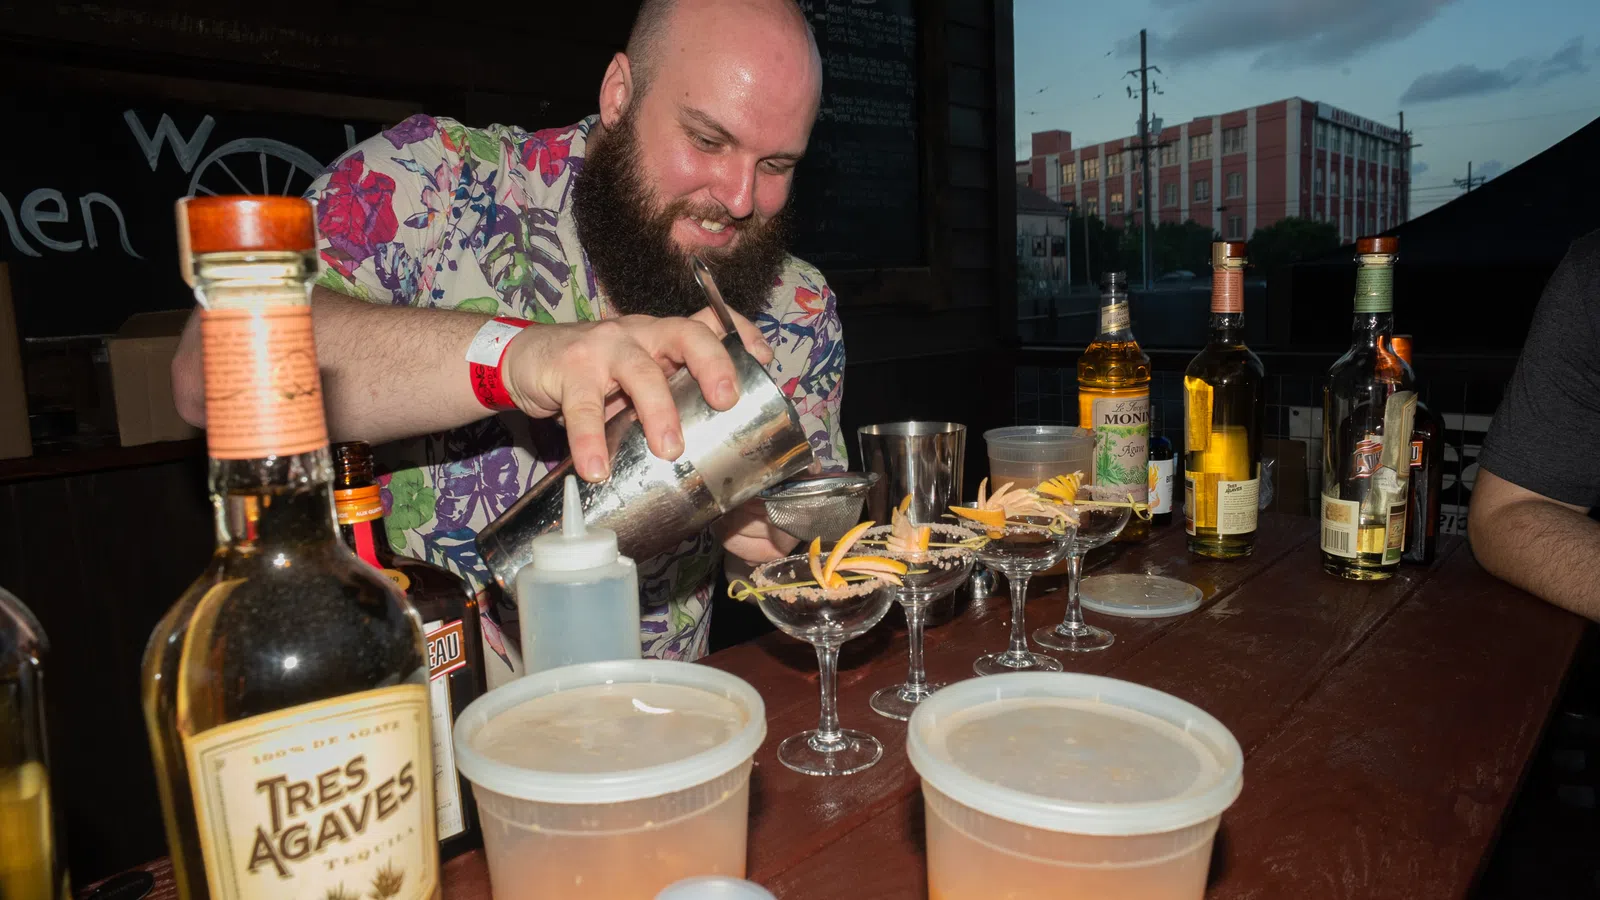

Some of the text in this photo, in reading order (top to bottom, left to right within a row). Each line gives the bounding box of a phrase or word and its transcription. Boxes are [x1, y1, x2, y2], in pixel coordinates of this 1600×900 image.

[1331, 107, 1361, 127] AMERICAN
[251, 719, 401, 766] 100% DE AGAVE
[255, 753, 368, 835] TRES
[246, 758, 418, 879] AGAVES
[321, 826, 416, 872] TEQUILA
